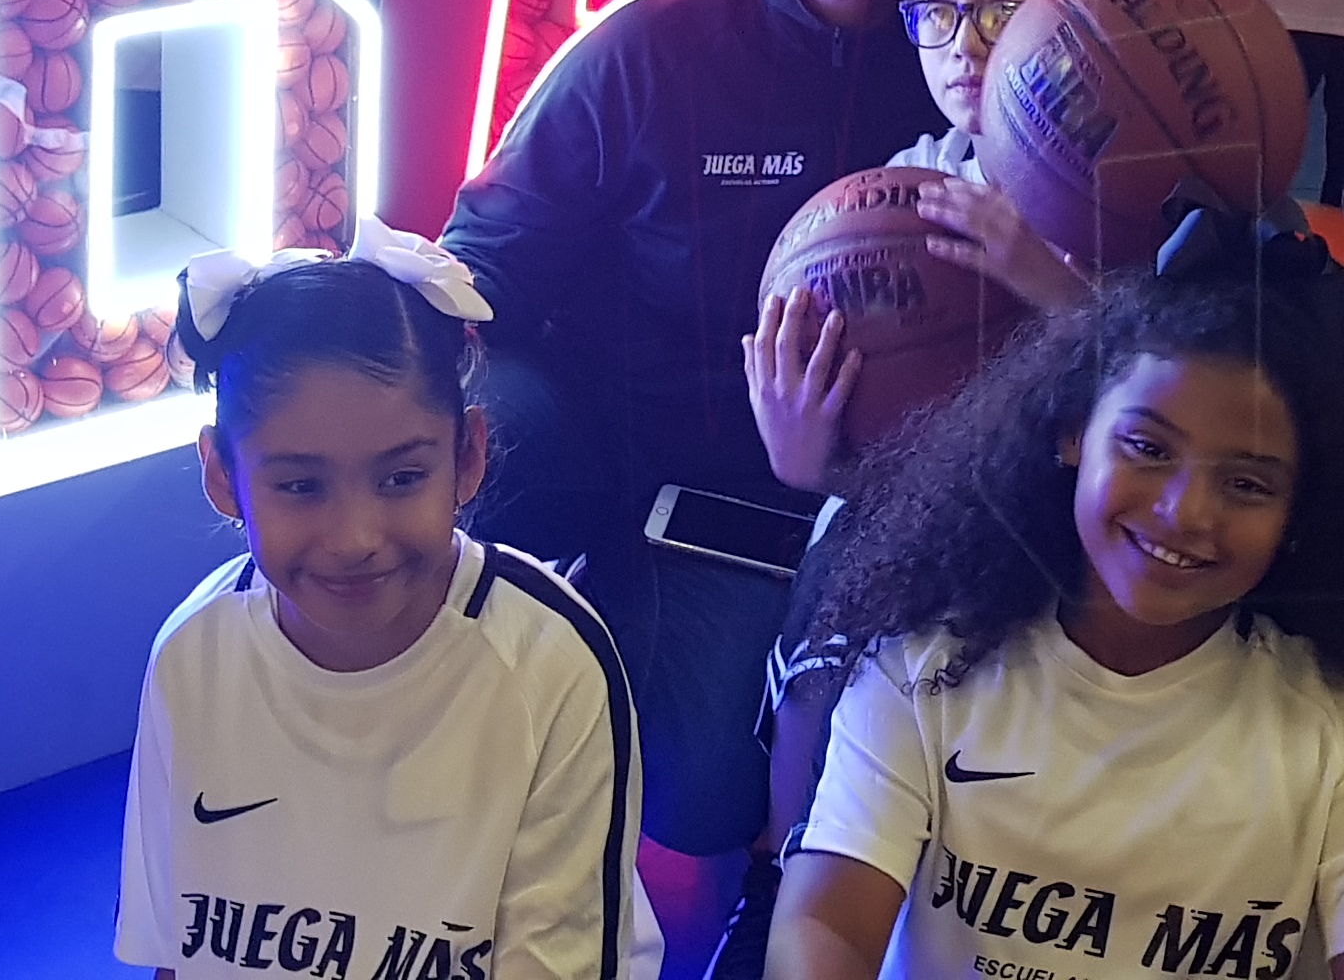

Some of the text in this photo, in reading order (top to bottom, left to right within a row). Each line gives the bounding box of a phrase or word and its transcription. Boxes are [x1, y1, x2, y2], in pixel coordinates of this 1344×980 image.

[701, 151, 805, 176] JUEGA MÁS
[180, 893, 357, 980] JUEGA
[931, 845, 1117, 959] JUEGA
